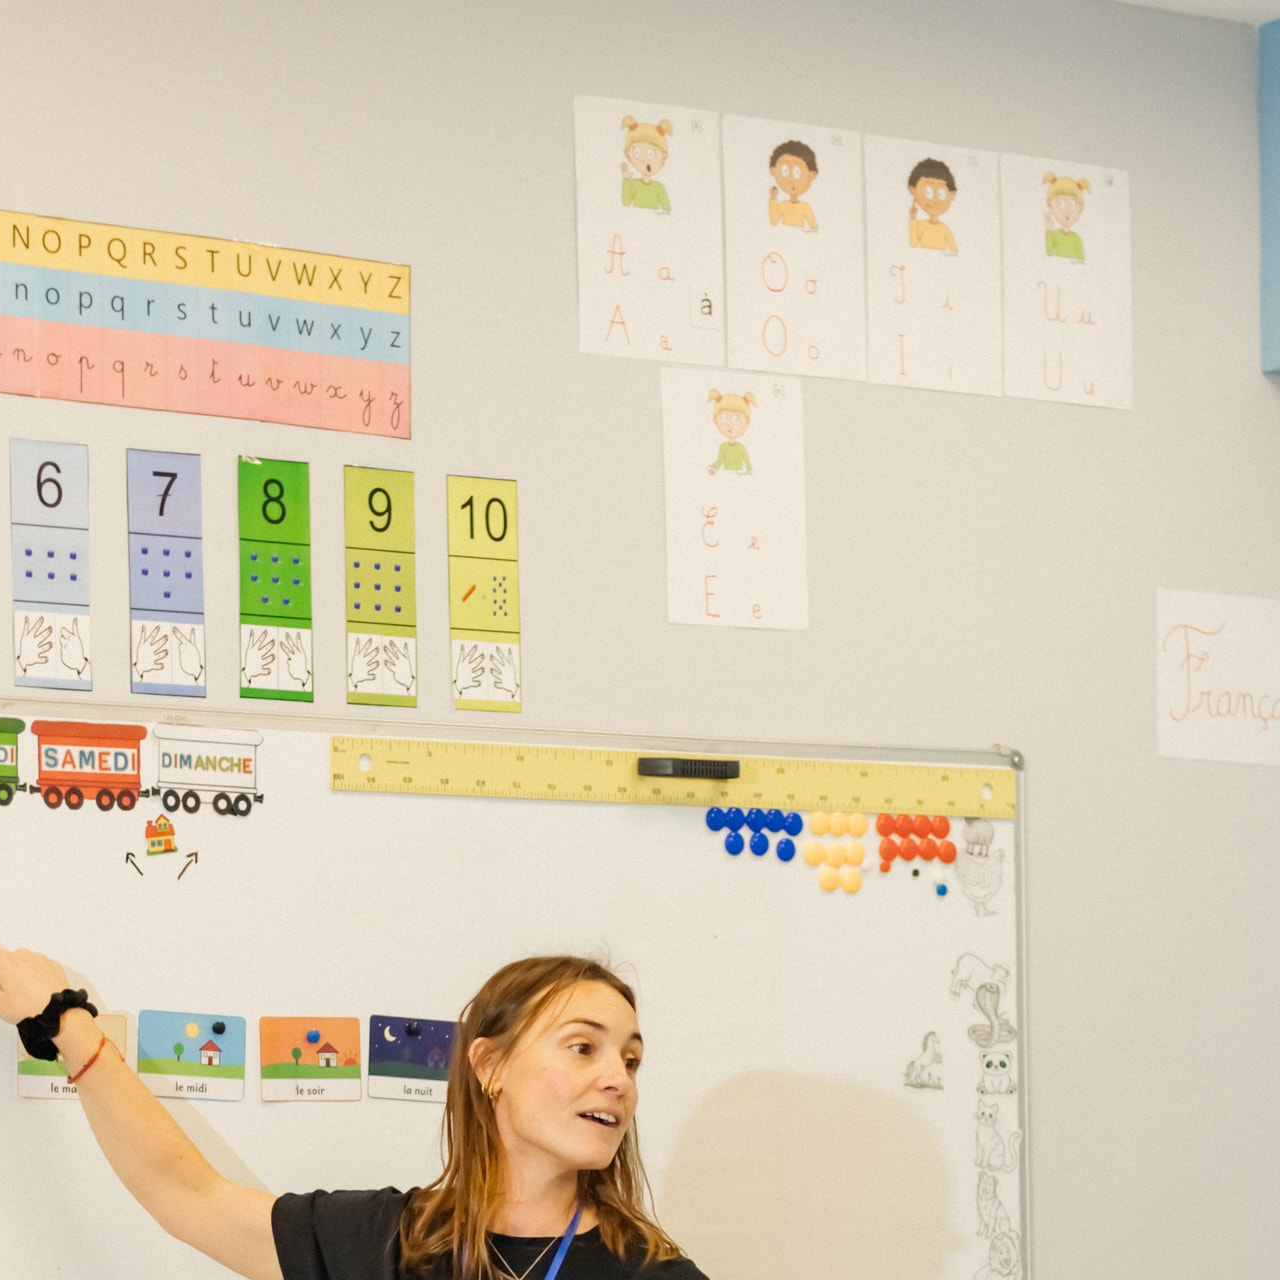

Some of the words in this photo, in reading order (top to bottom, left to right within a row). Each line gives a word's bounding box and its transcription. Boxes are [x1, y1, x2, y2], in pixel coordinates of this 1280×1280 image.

[13, 224, 29, 249] N
[42, 230, 61, 253] O
[79, 234, 91, 256] P
[107, 238, 127, 268] Q
[143, 242, 156, 266] R
[175, 246, 187, 269] S
[206, 250, 219, 272] T
[237, 254, 251, 277] U
[266, 258, 281, 281] V
[293, 262, 316, 286] W
[329, 268, 342, 290] X
[360, 272, 372, 294] Y
[388, 276, 402, 299] Z
[16, 283, 28, 300] n
[46, 288, 60, 305] o
[79, 291, 92, 315] p
[111, 296, 124, 320] q
[147, 300, 154, 316] r
[177, 303, 187, 320] s
[210, 303, 217, 324] t
[239, 311, 251, 327] u
[268, 314, 280, 331] v
[296, 319, 314, 336] w
[331, 323, 341, 340] x
[360, 327, 372, 350] y
[390, 331, 400, 348] z
[606, 304, 630, 345] A
[37, 461, 62, 508] 6
[153, 471, 177, 516] 7
[262, 479, 286, 524] 8
[368, 488, 392, 532] 9
[461, 496, 507, 541] 10
[44, 747, 137, 773] SAMEDI
[162, 752, 253, 774] DIMANCHE
[51, 1083, 59, 1093] le
[63, 1086, 77, 1094] ma
[175, 1082, 184, 1091] le
[186, 1083, 207, 1093] midi
[296, 1085, 304, 1095] le
[307, 1086, 325, 1096] soir
[403, 1085, 412, 1095] la
[415, 1086, 433, 1096] nuit
